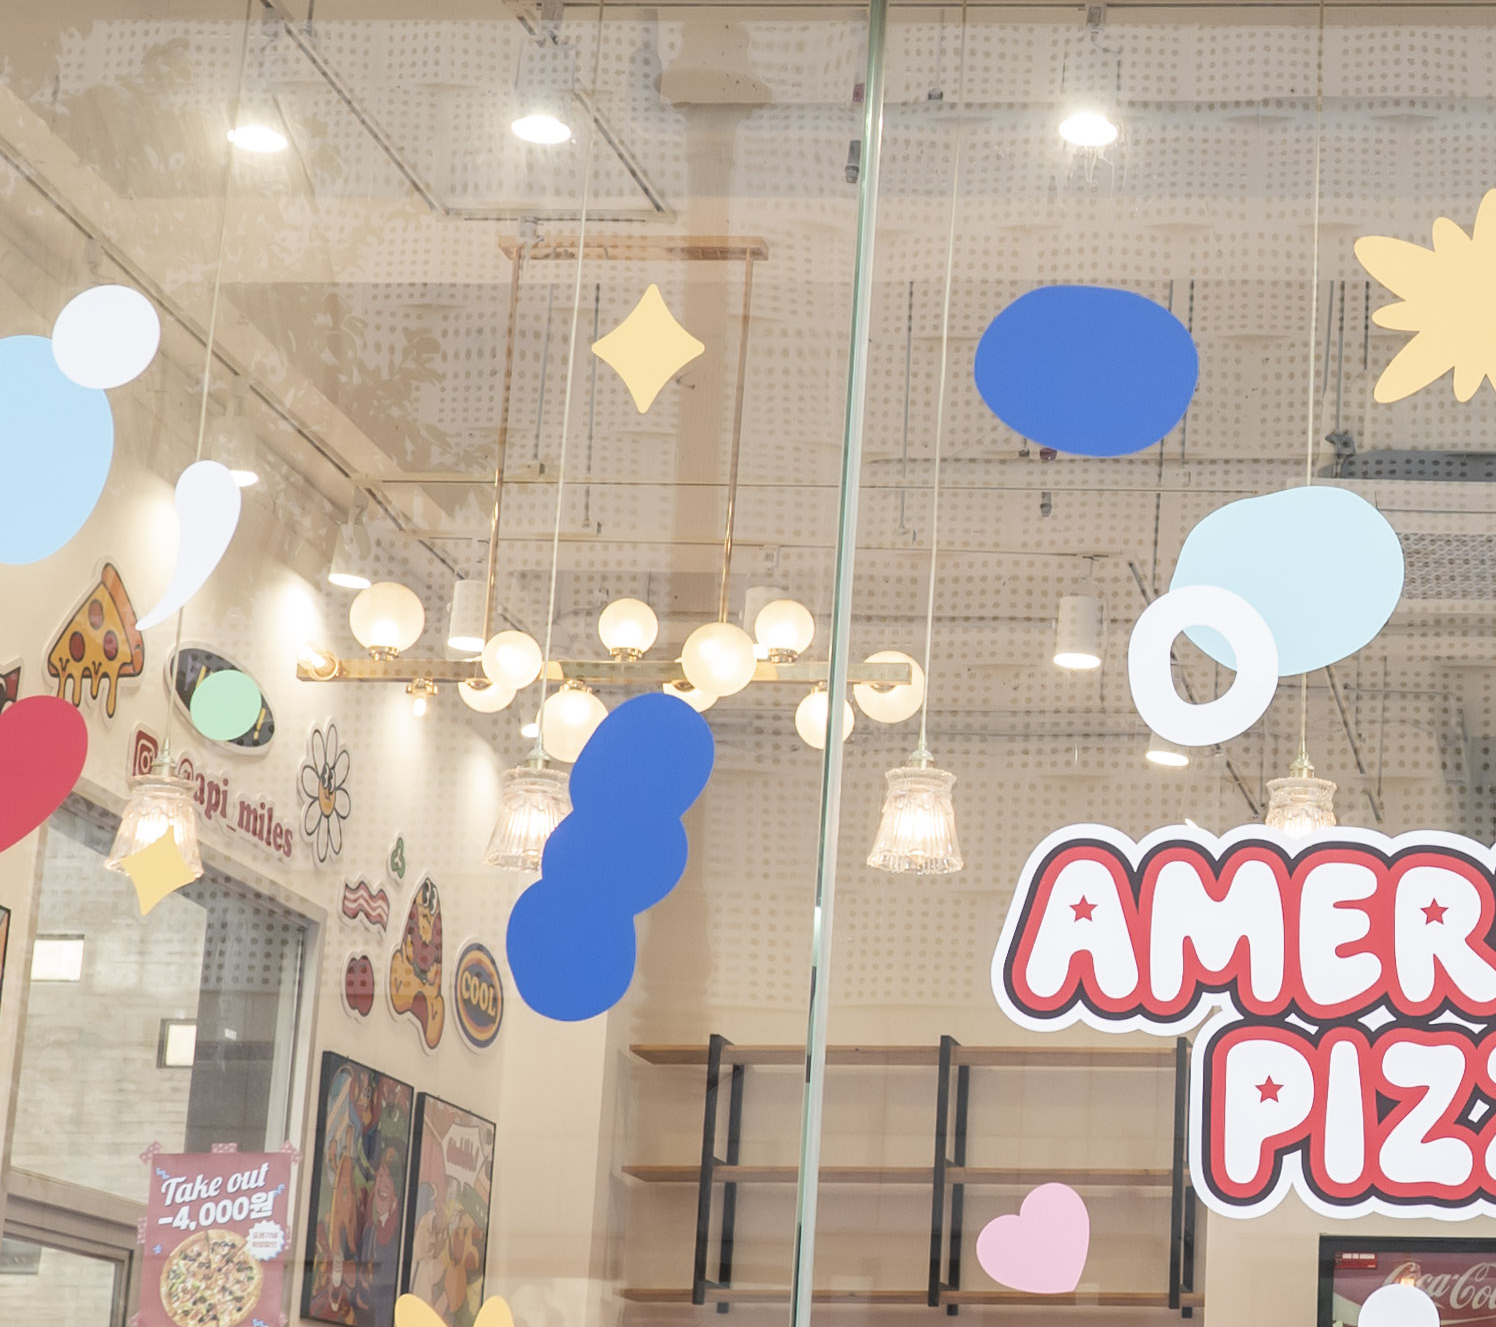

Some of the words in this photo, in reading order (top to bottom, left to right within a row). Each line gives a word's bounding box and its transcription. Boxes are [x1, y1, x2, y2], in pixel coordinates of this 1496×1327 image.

[462, 970, 496, 1018] COOL
[161, 1175, 223, 1207] Take
[227, 1162, 270, 1193] out
